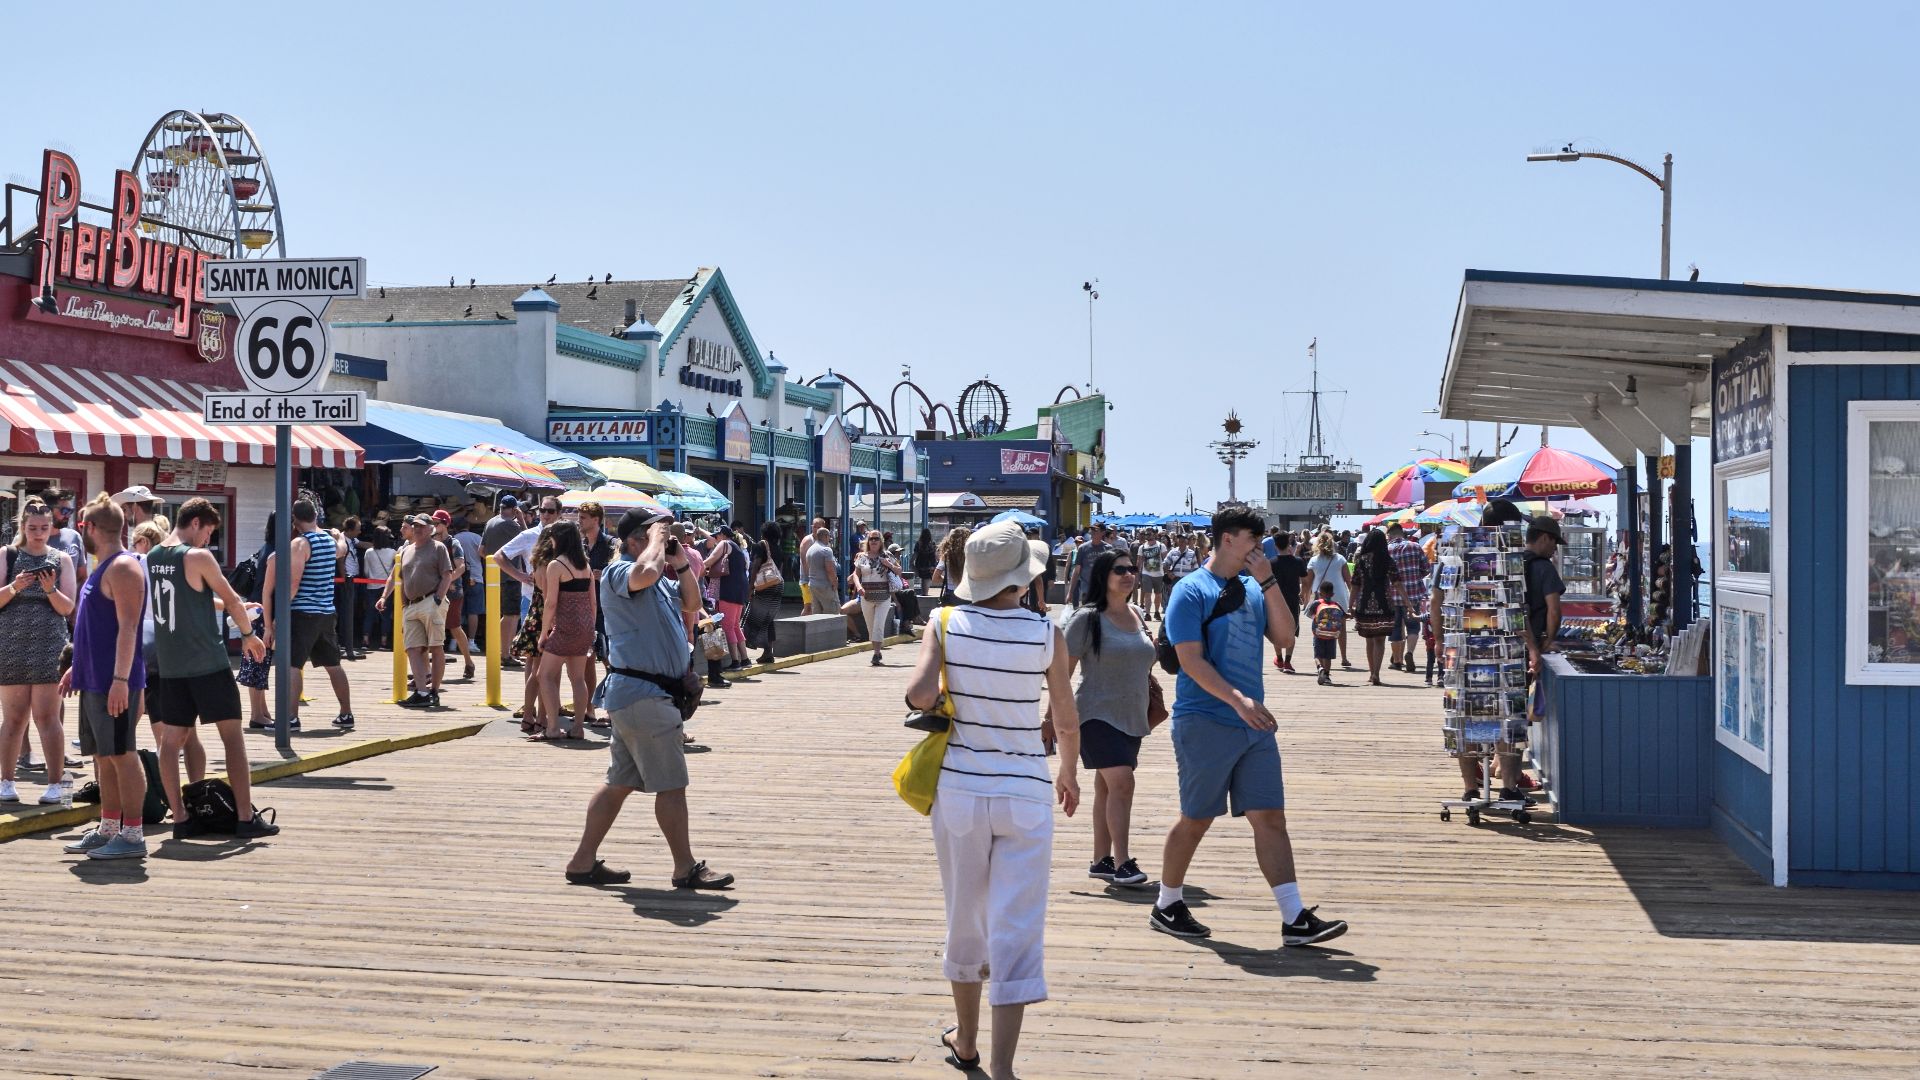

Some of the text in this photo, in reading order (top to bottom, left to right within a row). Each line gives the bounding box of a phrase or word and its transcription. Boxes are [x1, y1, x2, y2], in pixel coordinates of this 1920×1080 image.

[111, 168, 211, 338] Burge
[210, 265, 354, 292] SANTA MONICA
[248, 316, 315, 380] 66
[1718, 363, 1771, 415] OATMAN
[211, 397, 352, 419] End of the Trail
[551, 421, 646, 436] PLAYLAND
[1720, 412, 1744, 442] ROCK
[1010, 460, 1036, 472] Shop
[1018, 453, 1030, 462] GIFT
[1460, 481, 1598, 494] CHRROS CHURROS
[151, 564, 176, 575] STAFF
[154, 578, 176, 634] 17
